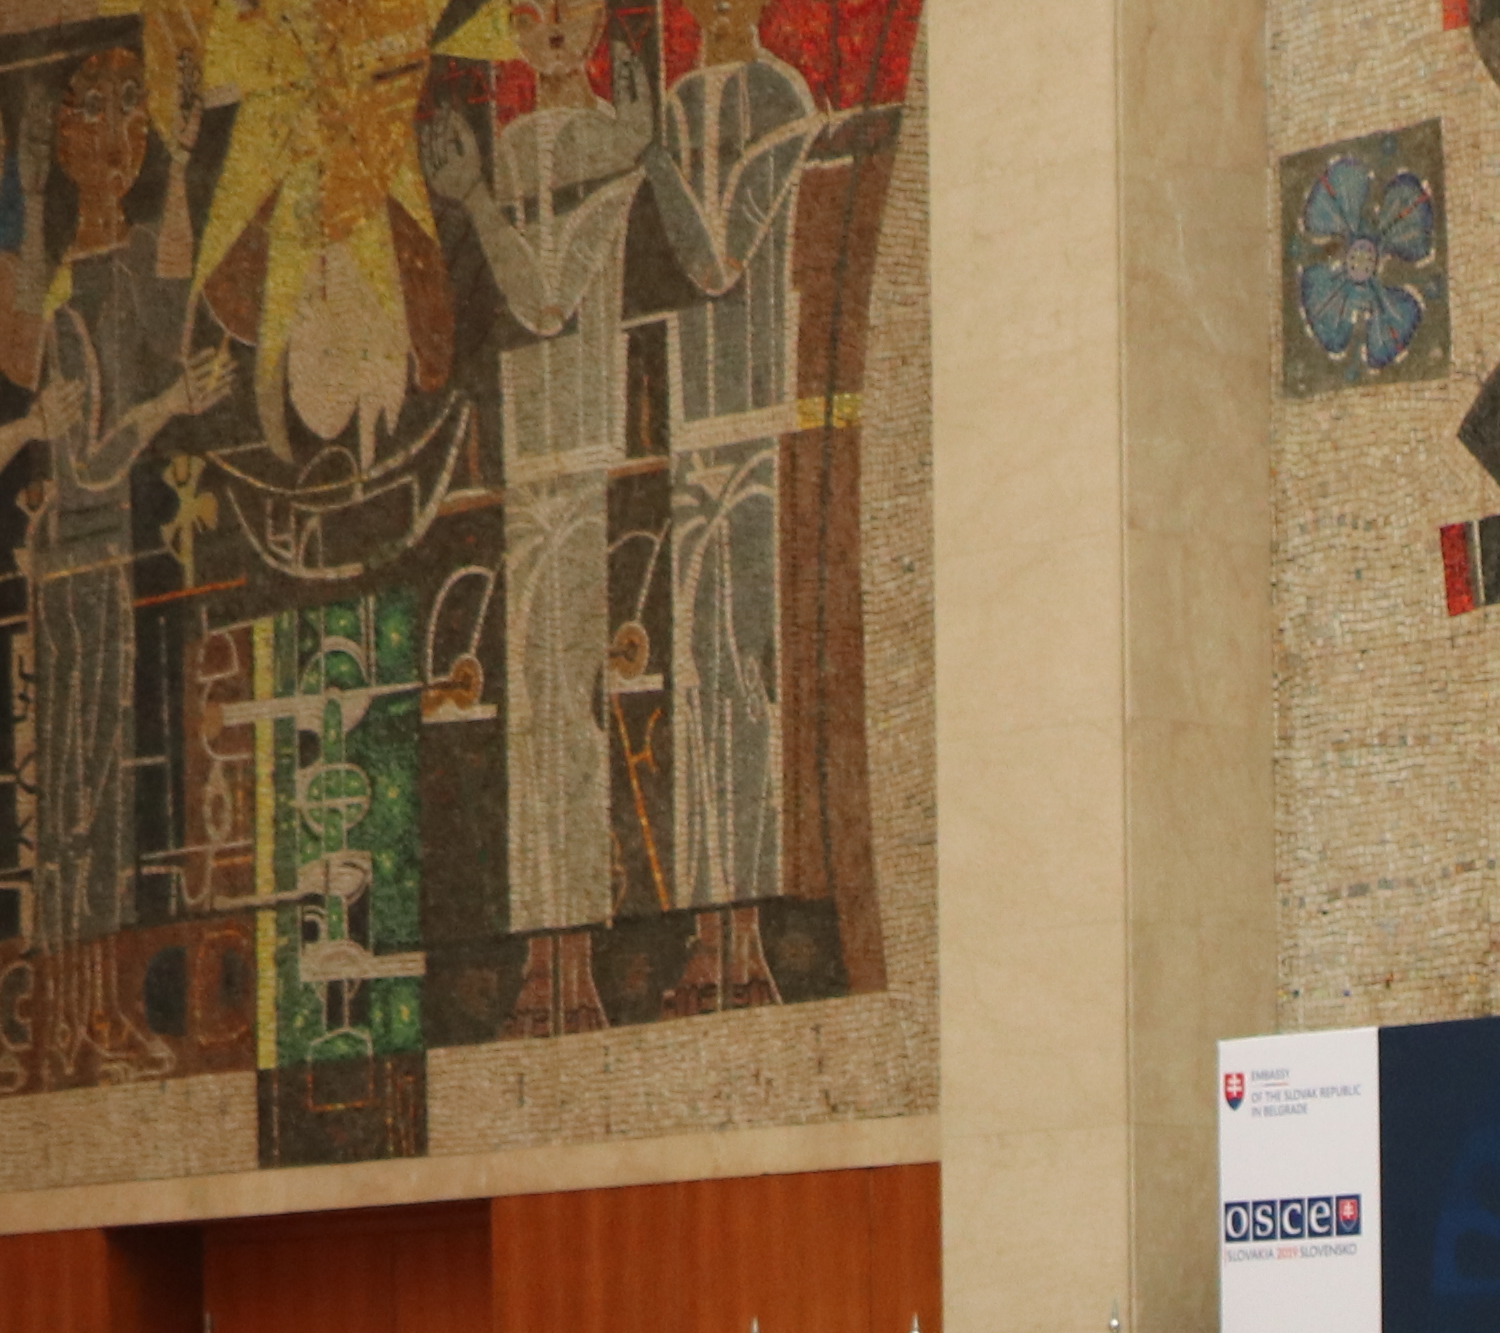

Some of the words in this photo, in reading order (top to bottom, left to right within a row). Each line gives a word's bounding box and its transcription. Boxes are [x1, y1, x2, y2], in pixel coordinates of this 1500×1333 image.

[1251, 1068, 1290, 1081] EMBASSY
[1251, 1091, 1264, 1104] OF
[1265, 1089, 1281, 1102] THE
[1284, 1087, 1317, 1100] SLOVAK
[1319, 1084, 1362, 1098] REPUBLIC
[1264, 1103, 1308, 1117] BELGRADE
[1228, 1249, 1274, 1263] SLOVAKIA
[1300, 1243, 1358, 1258] SLOVENSKO
